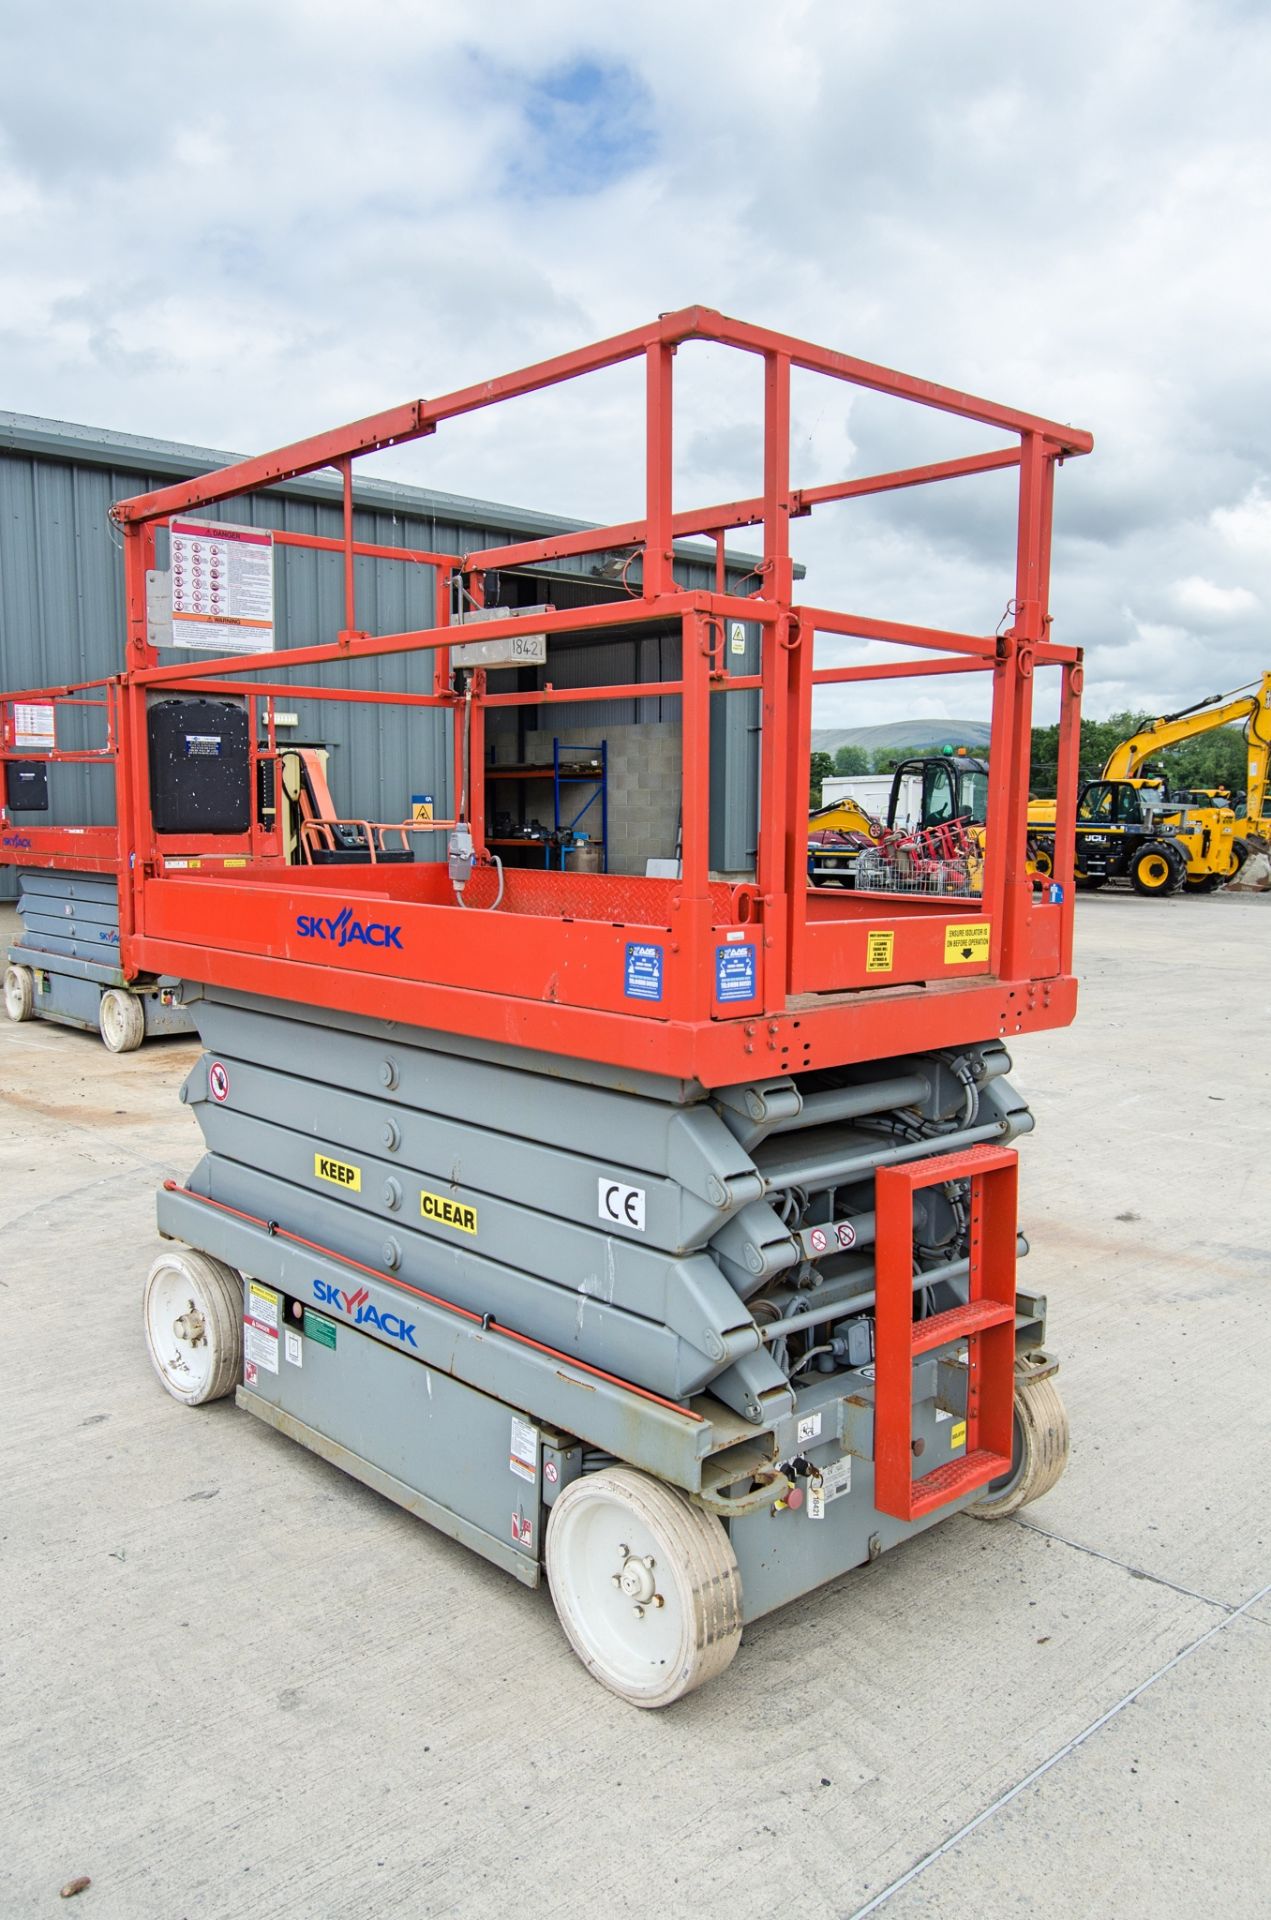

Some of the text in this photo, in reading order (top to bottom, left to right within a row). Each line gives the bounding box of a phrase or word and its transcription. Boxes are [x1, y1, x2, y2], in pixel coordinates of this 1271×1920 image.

[213, 529, 240, 540] DANGER
[214, 616, 241, 626] WARNING
[296, 906, 404, 950] SKYJACK
[320, 1159, 355, 1184] KEEP
[422, 1196, 475, 1230] CLEAR
[313, 1279, 418, 1348] SKYJACK
